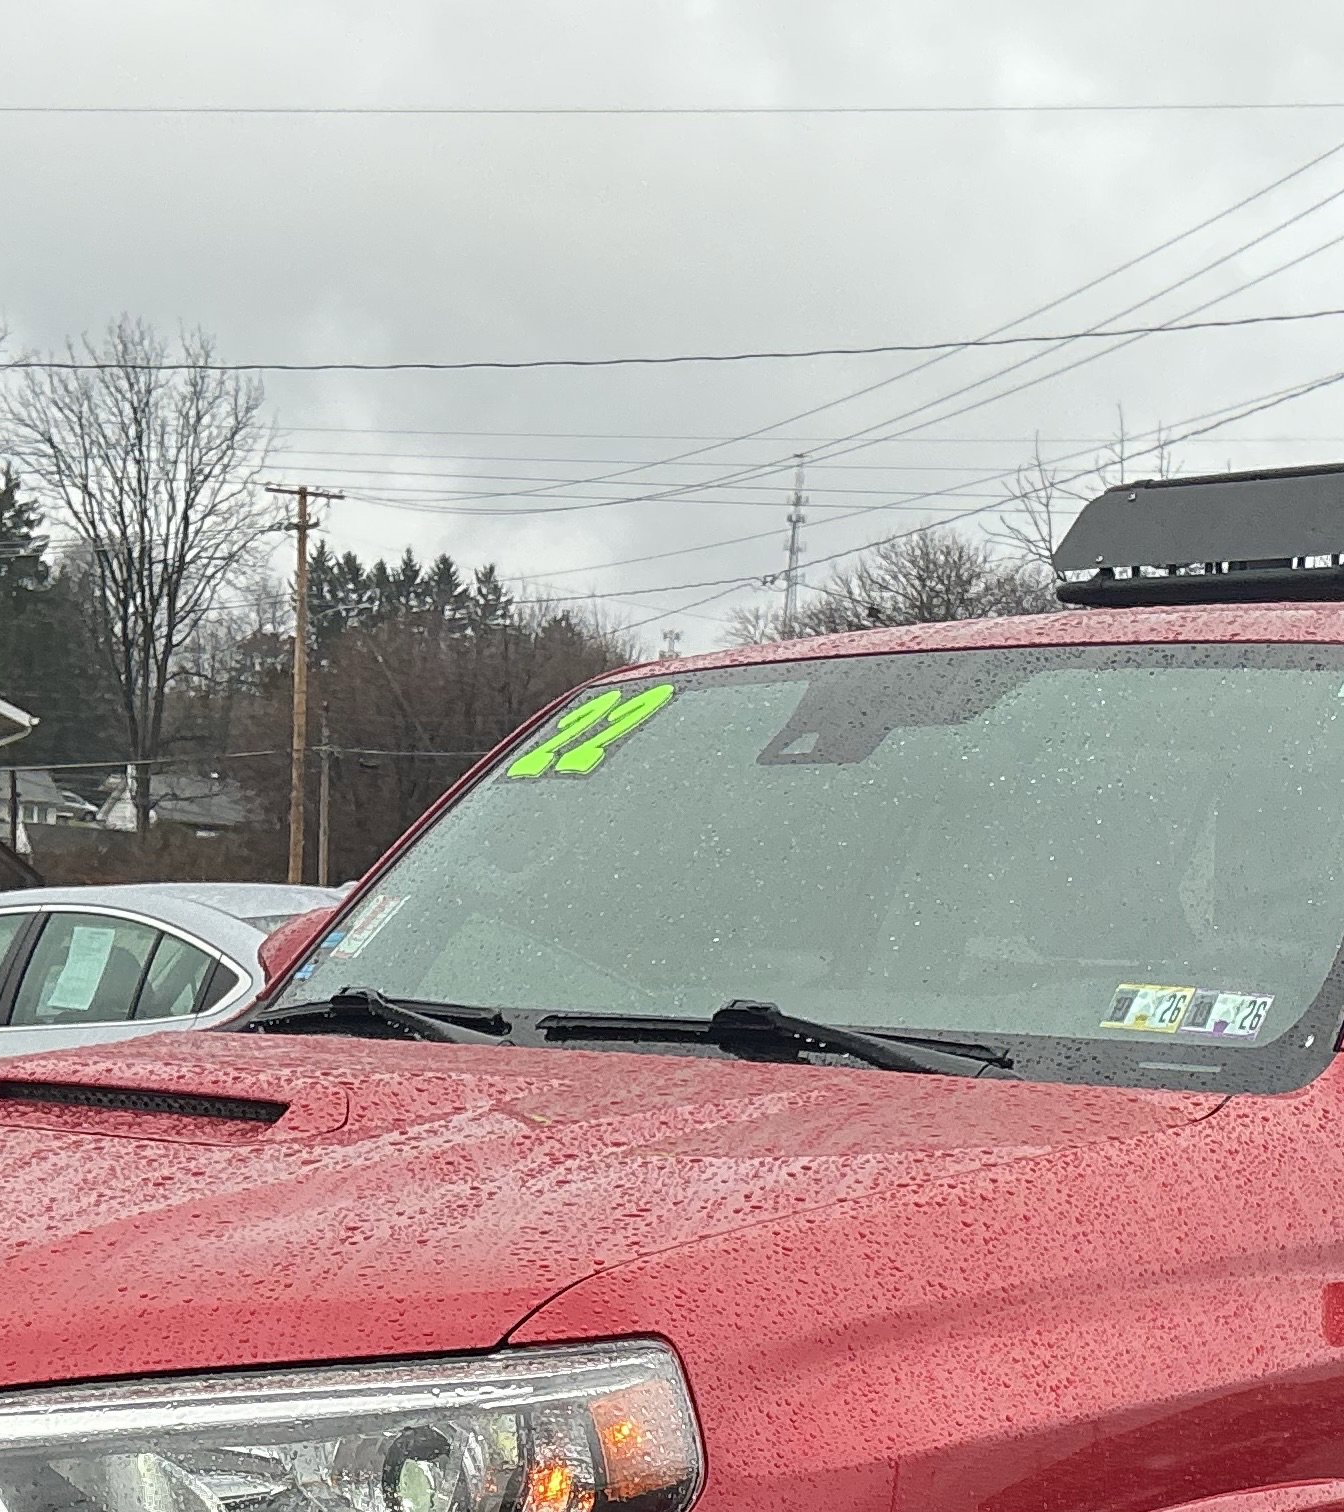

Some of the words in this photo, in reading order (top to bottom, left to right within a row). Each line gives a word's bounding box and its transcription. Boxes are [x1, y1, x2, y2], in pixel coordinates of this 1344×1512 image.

[506, 683, 676, 780] 22
[1158, 993, 1187, 1024] 26
[1238, 1000, 1268, 1031] 26
